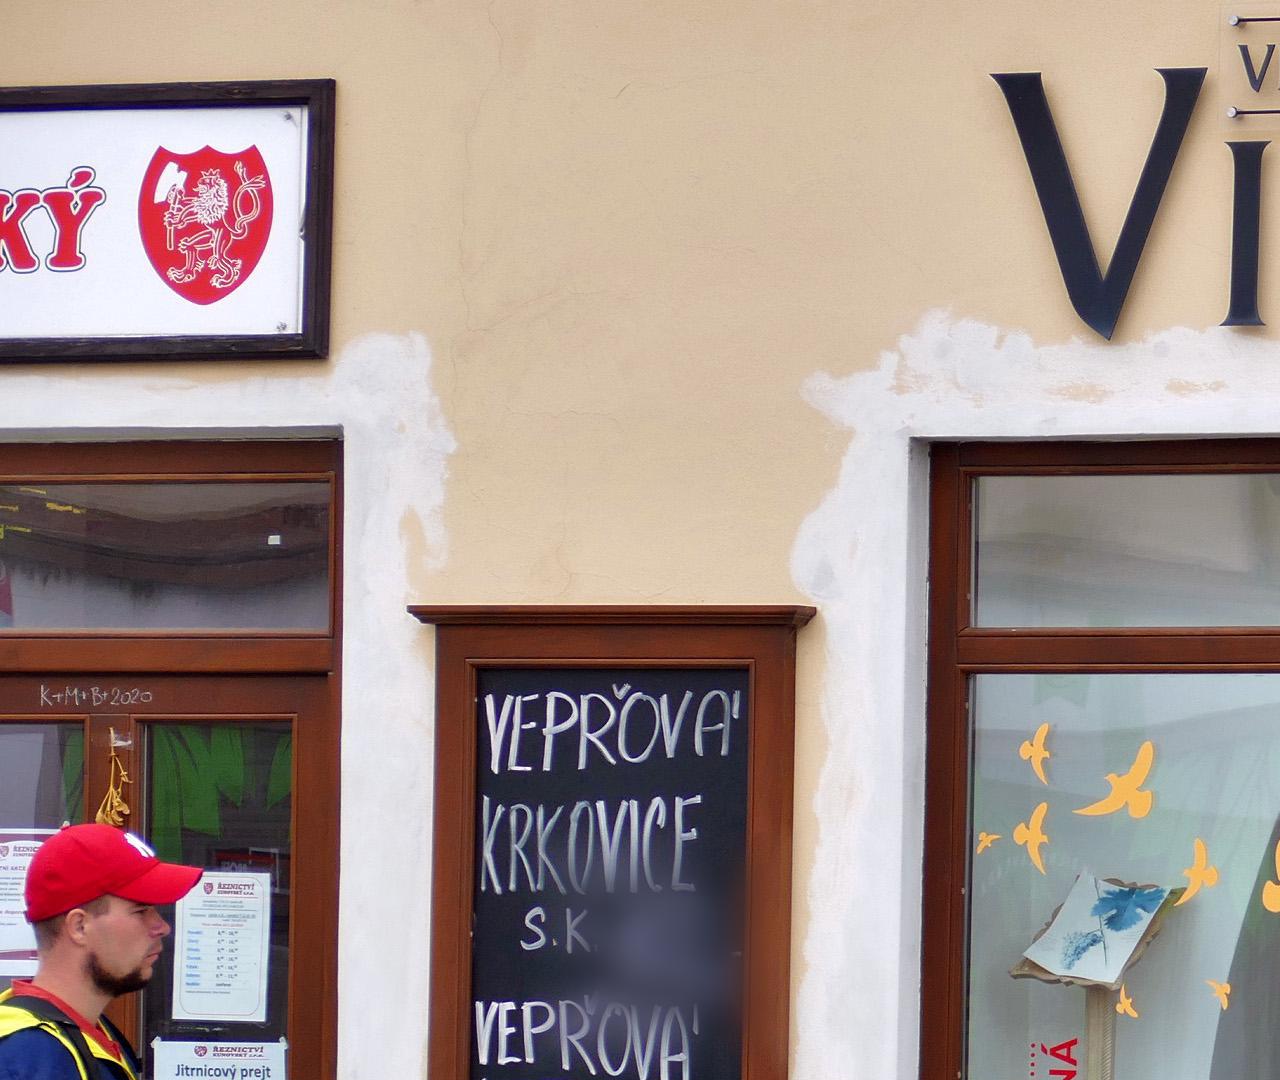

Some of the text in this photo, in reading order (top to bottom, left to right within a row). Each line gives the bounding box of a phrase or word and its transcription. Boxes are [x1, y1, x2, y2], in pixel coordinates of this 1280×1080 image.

[481, 795, 701, 895] KRKOVICE
[176, 1064, 271, 1080] Jitrnicový prejt
